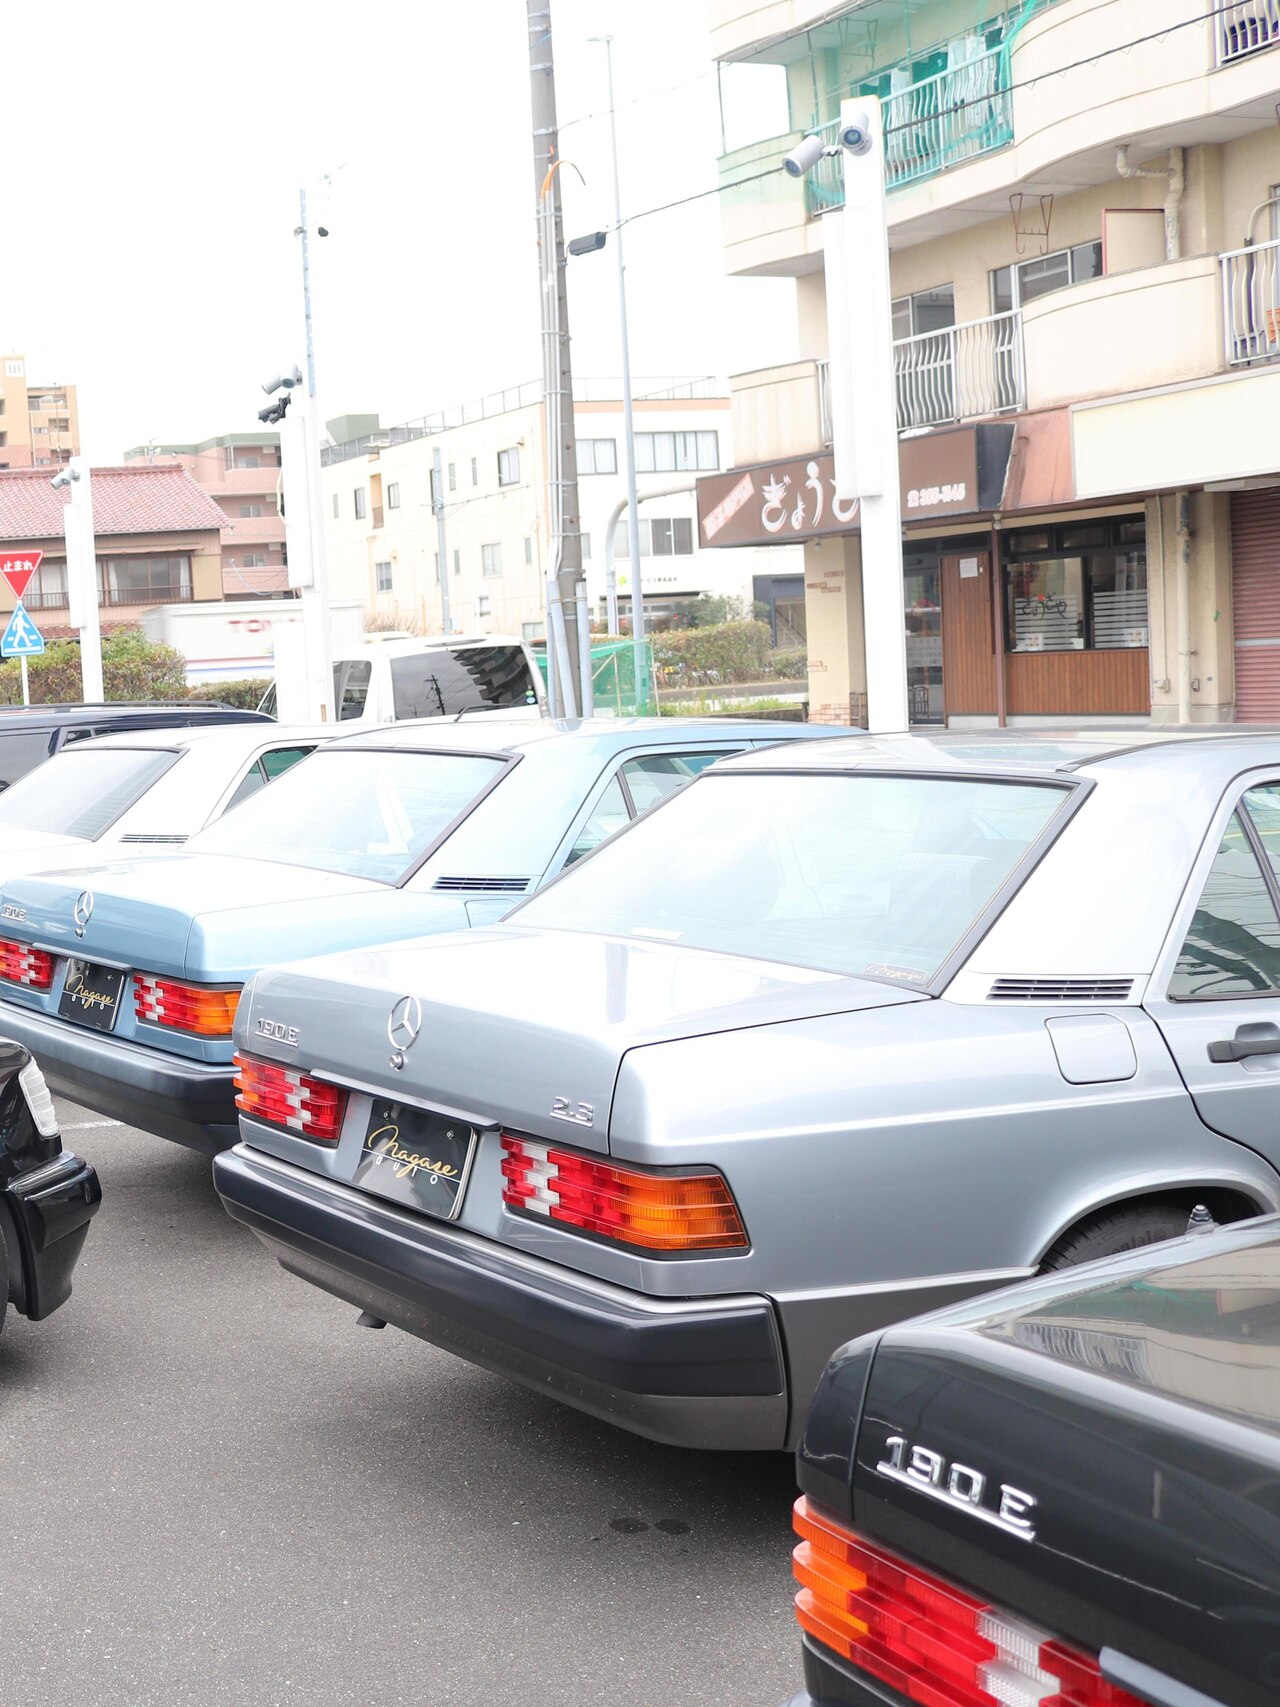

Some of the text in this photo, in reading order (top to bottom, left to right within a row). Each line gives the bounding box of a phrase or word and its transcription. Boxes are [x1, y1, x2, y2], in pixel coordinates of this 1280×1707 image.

[3, 560, 33, 572] 止まれ
[66, 974, 114, 1009] Nagase
[551, 1096, 595, 1122] 2.3
[368, 1124, 458, 1178] Nagase
